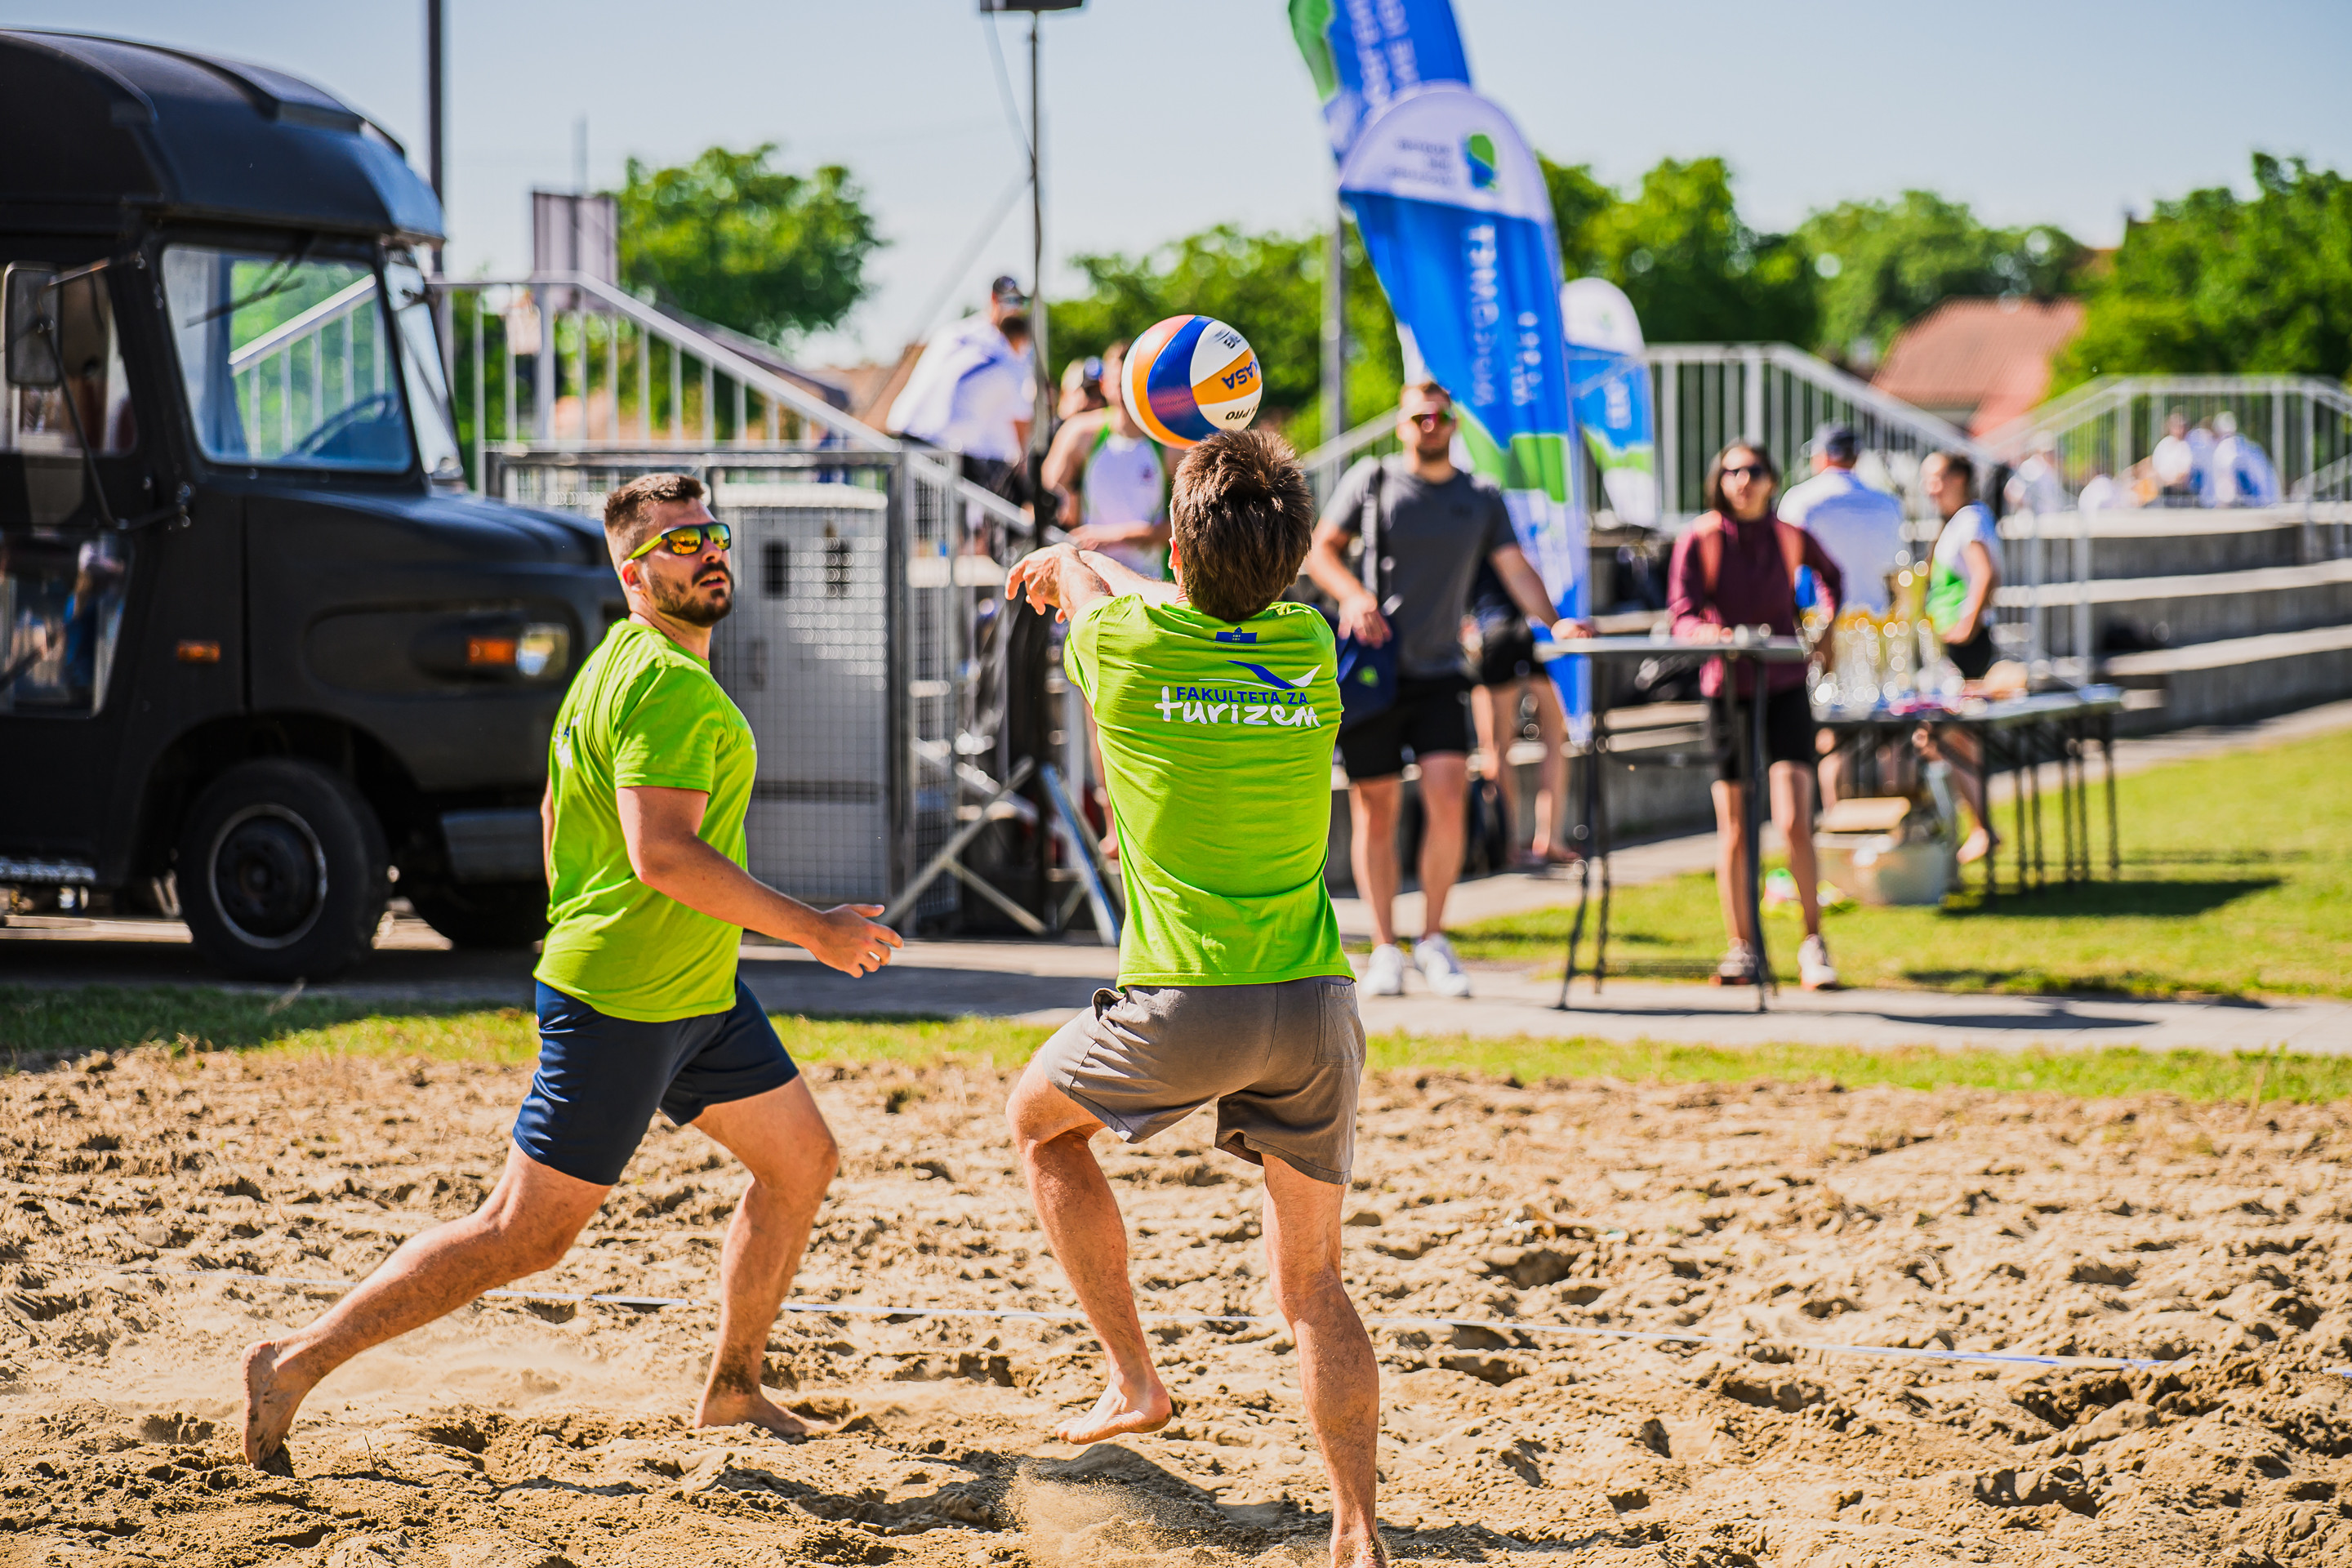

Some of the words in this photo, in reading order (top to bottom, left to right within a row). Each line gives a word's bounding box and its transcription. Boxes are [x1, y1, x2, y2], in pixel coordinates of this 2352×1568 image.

[1225, 408, 1250, 421] PRO
[1176, 686, 1282, 704] FAKULTETA
[1287, 692, 1310, 705] ZA
[1154, 685, 1321, 728] turizem
